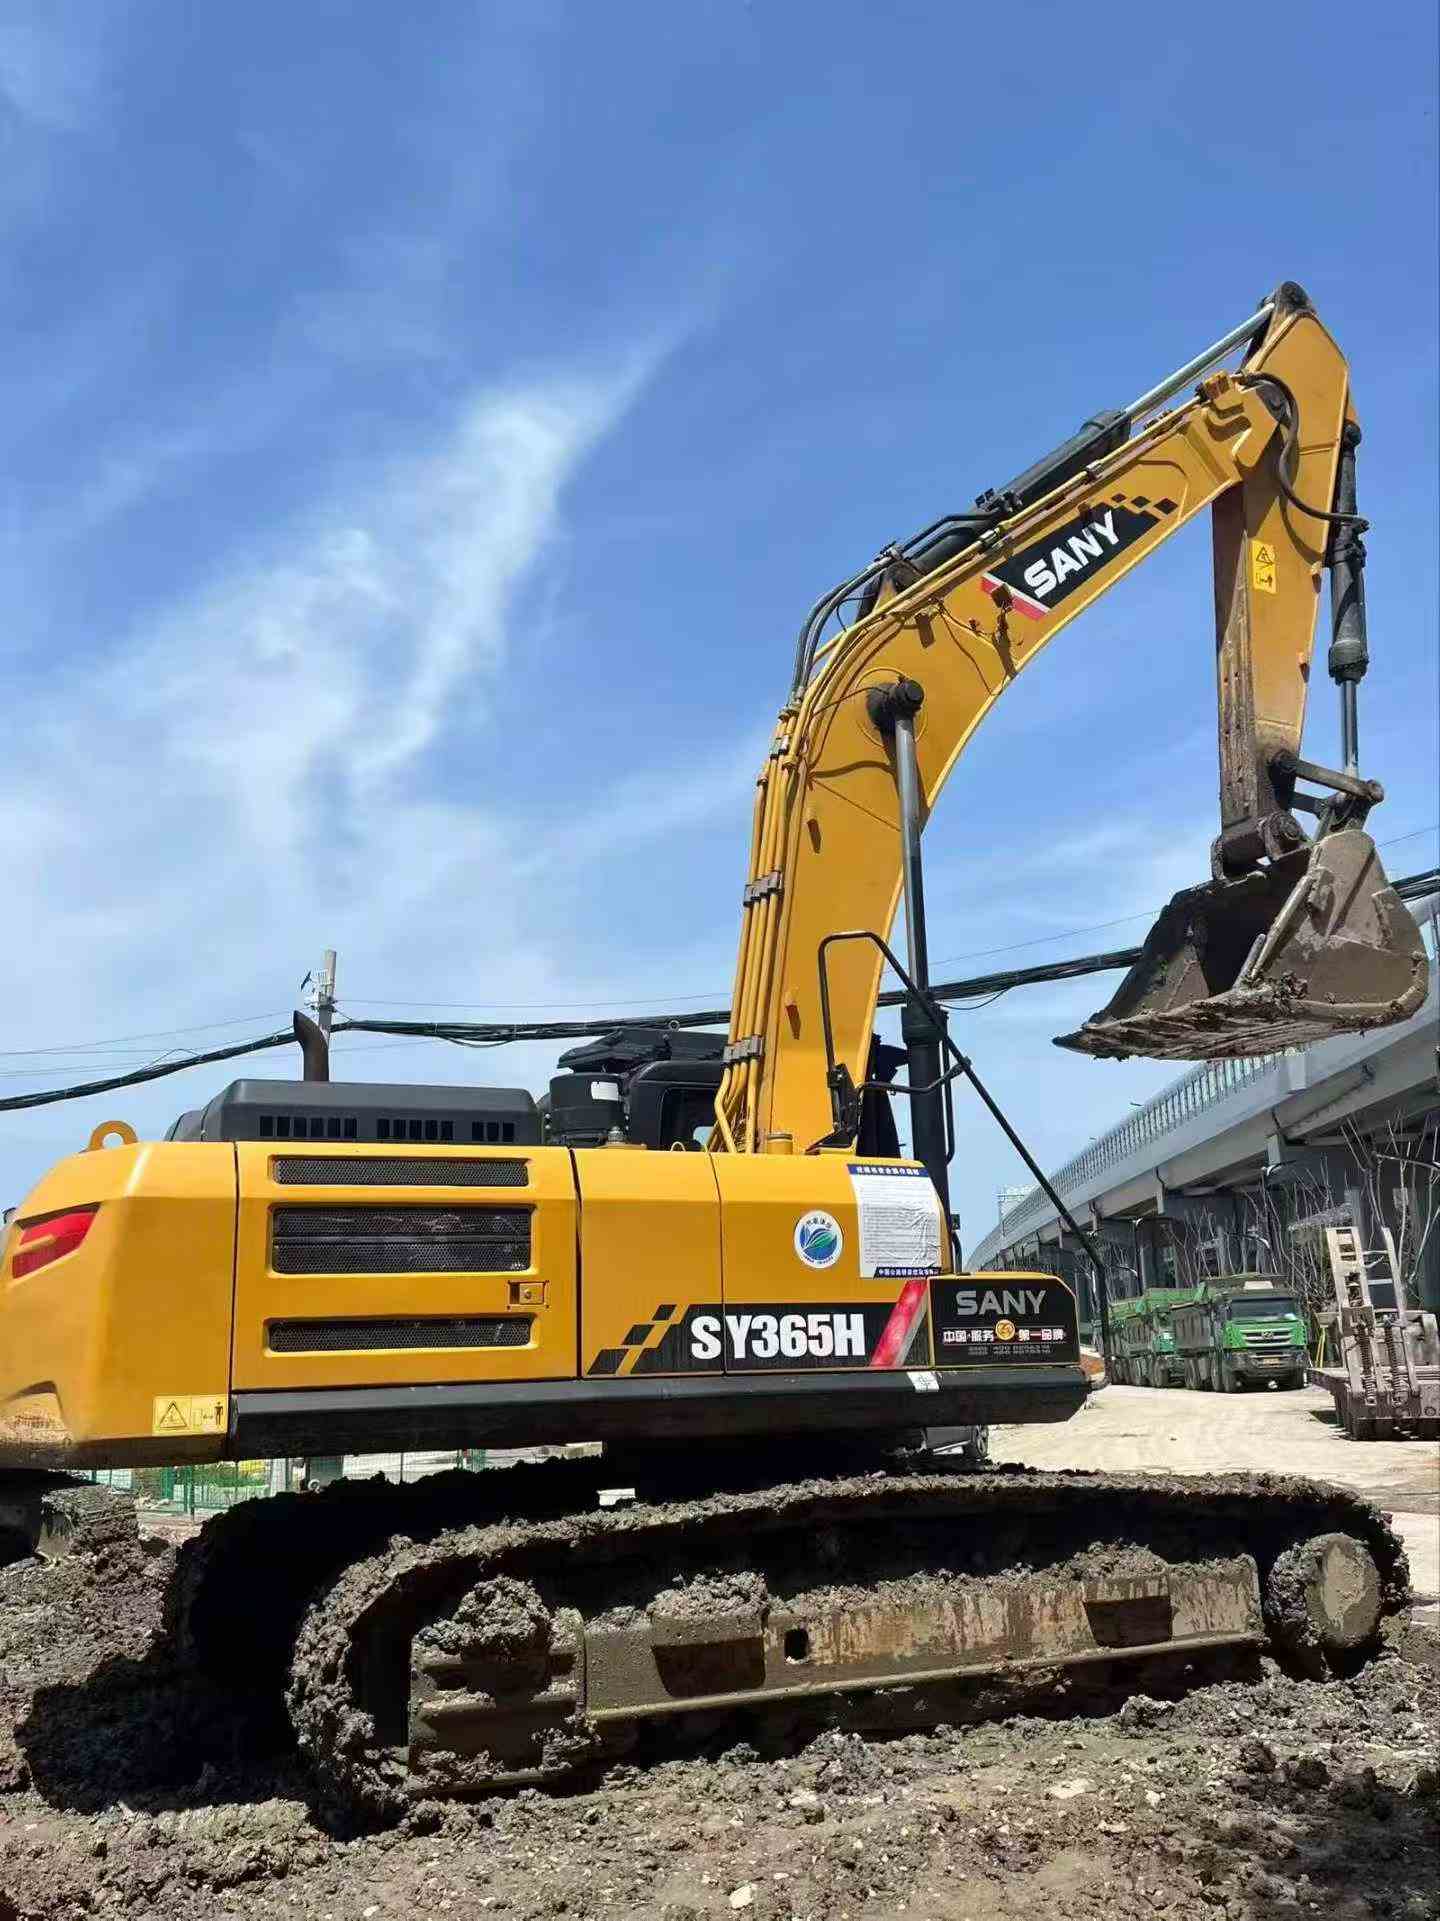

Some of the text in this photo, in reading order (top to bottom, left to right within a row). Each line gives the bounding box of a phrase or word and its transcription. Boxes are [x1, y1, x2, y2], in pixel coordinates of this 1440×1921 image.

[1023, 509, 1119, 599] SANY
[956, 1289, 1047, 1315] SANY
[690, 1313, 866, 1360] SY365H
